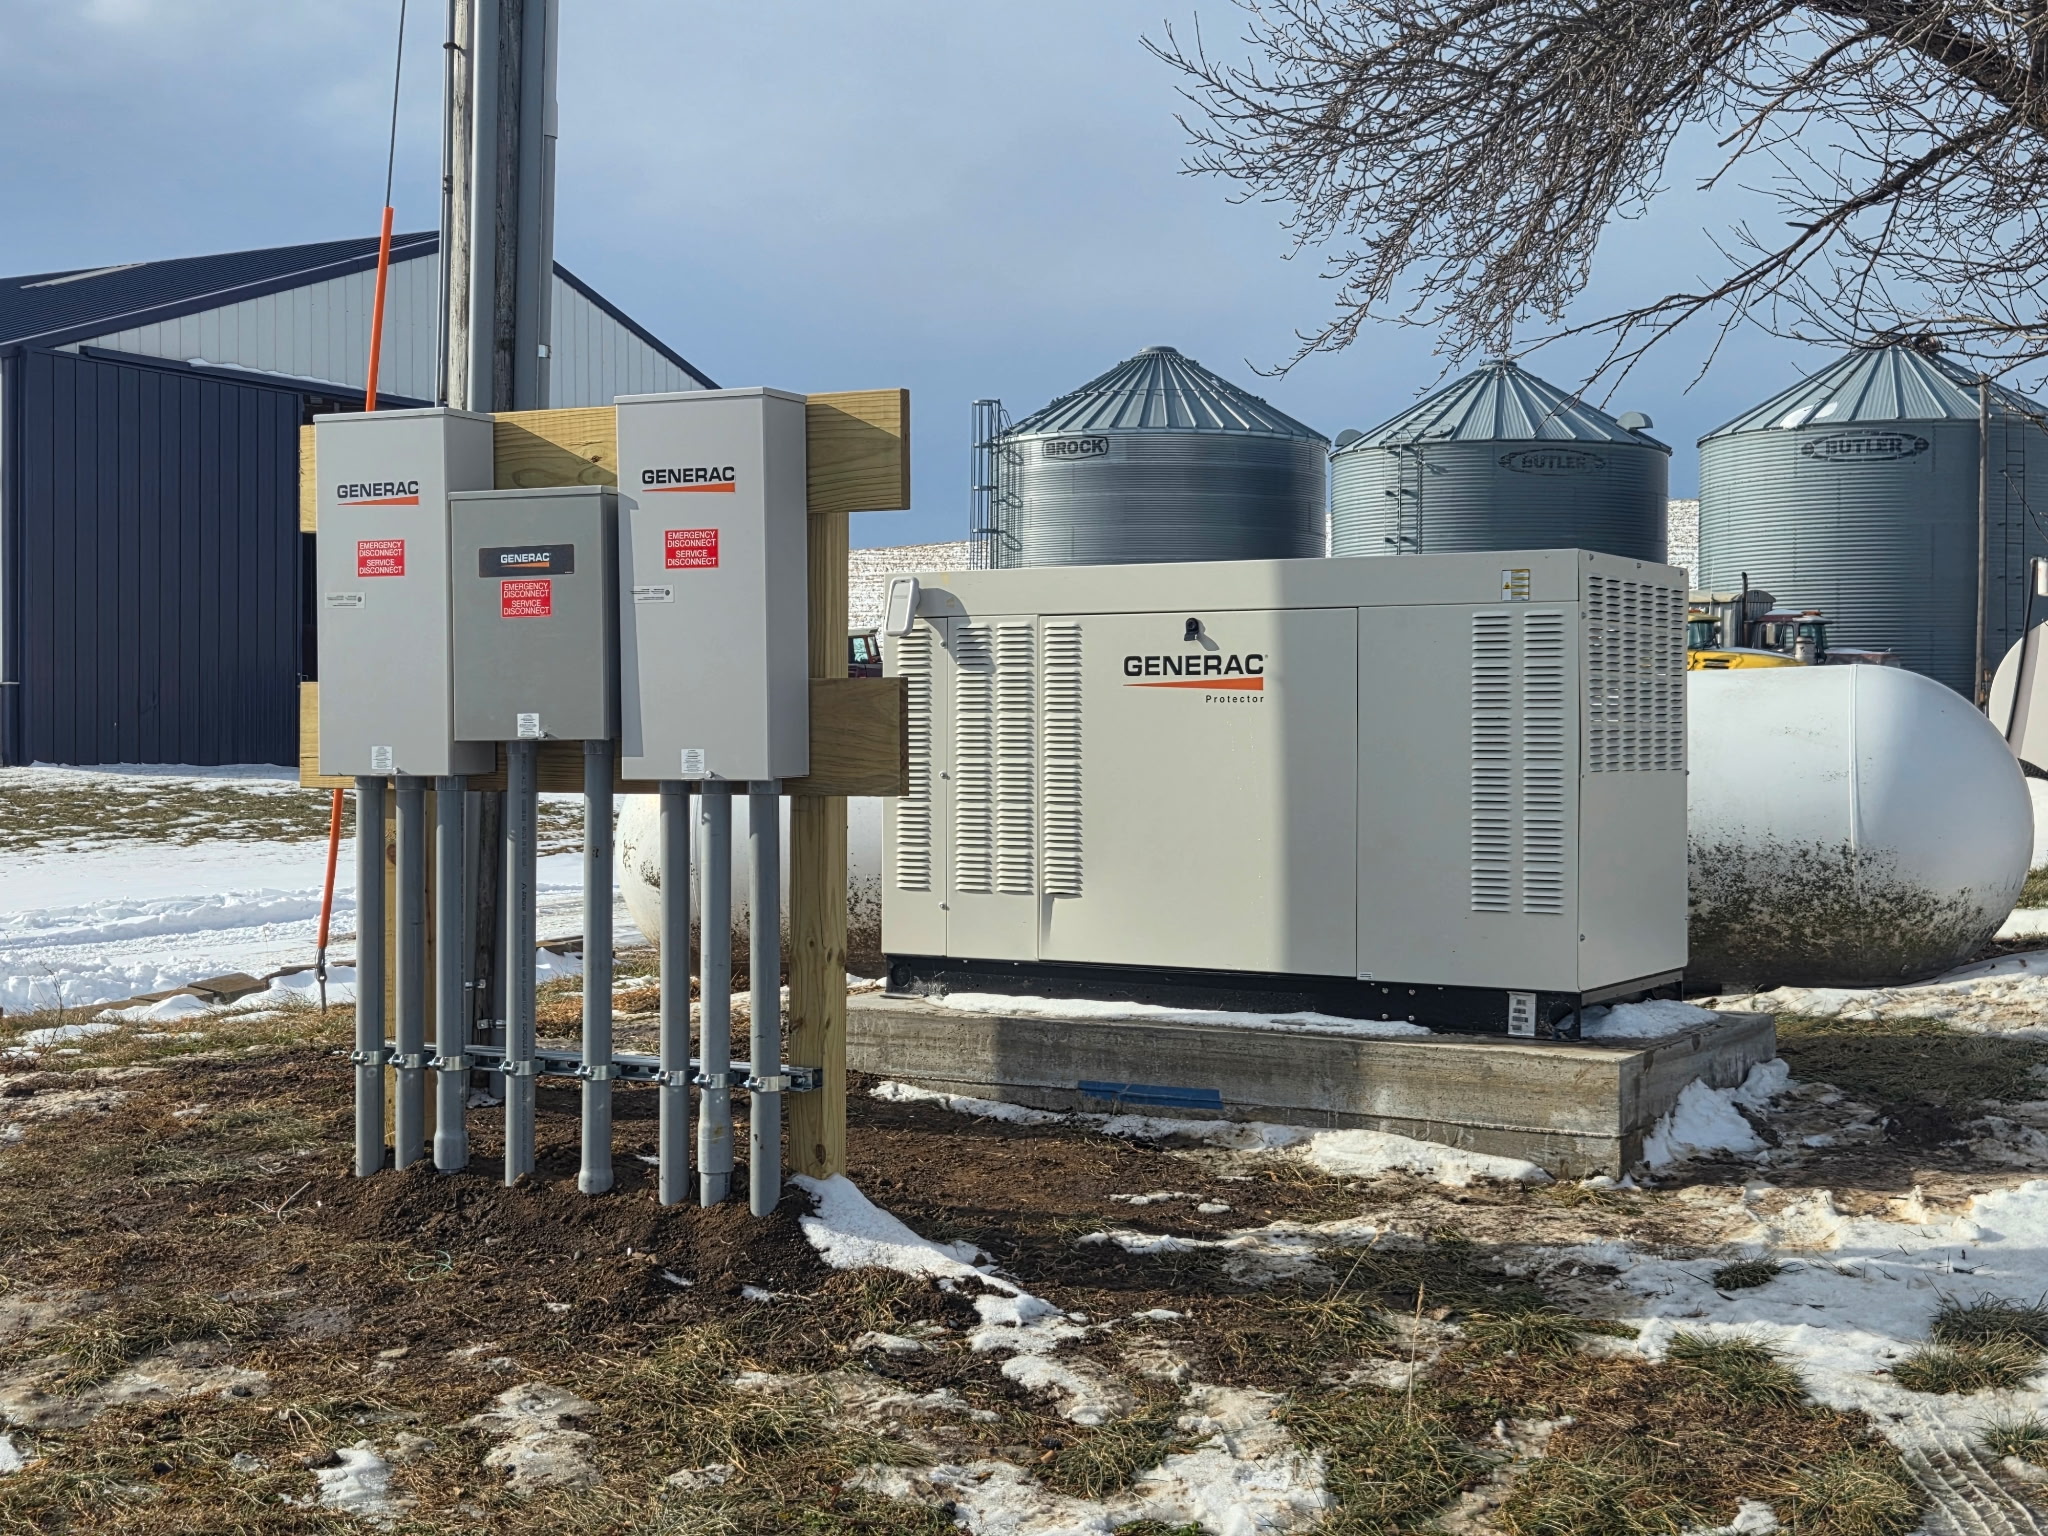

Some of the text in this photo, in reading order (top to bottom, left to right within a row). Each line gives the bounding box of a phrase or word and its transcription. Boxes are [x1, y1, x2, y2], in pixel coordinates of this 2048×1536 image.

[1044, 440, 1104, 455] BROCK
[1825, 438, 1902, 454] BUTLER
[1522, 455, 1586, 468] BUTLER
[641, 466, 735, 484] GENERAC
[337, 481, 419, 498] GENERAC
[668, 531, 715, 539] EMERGENCY
[359, 541, 402, 549] EMERGENCY
[667, 539, 716, 547] DISCONNECT
[359, 549, 402, 557] DISCONNECT
[675, 550, 707, 558] SERVICE
[500, 552, 550, 563] GENERAC
[366, 559, 395, 567] SERVICE
[667, 558, 716, 566] DISCONNECT
[359, 566, 402, 574] DISCONNECT
[504, 583, 548, 591] EMERGENCY
[503, 590, 549, 598] DISCONNECT
[511, 600, 541, 608] SERVICE
[503, 607, 549, 615] DISCONNECT
[1123, 654, 1264, 676] GENERAC
[1205, 695, 1265, 703] Protector
